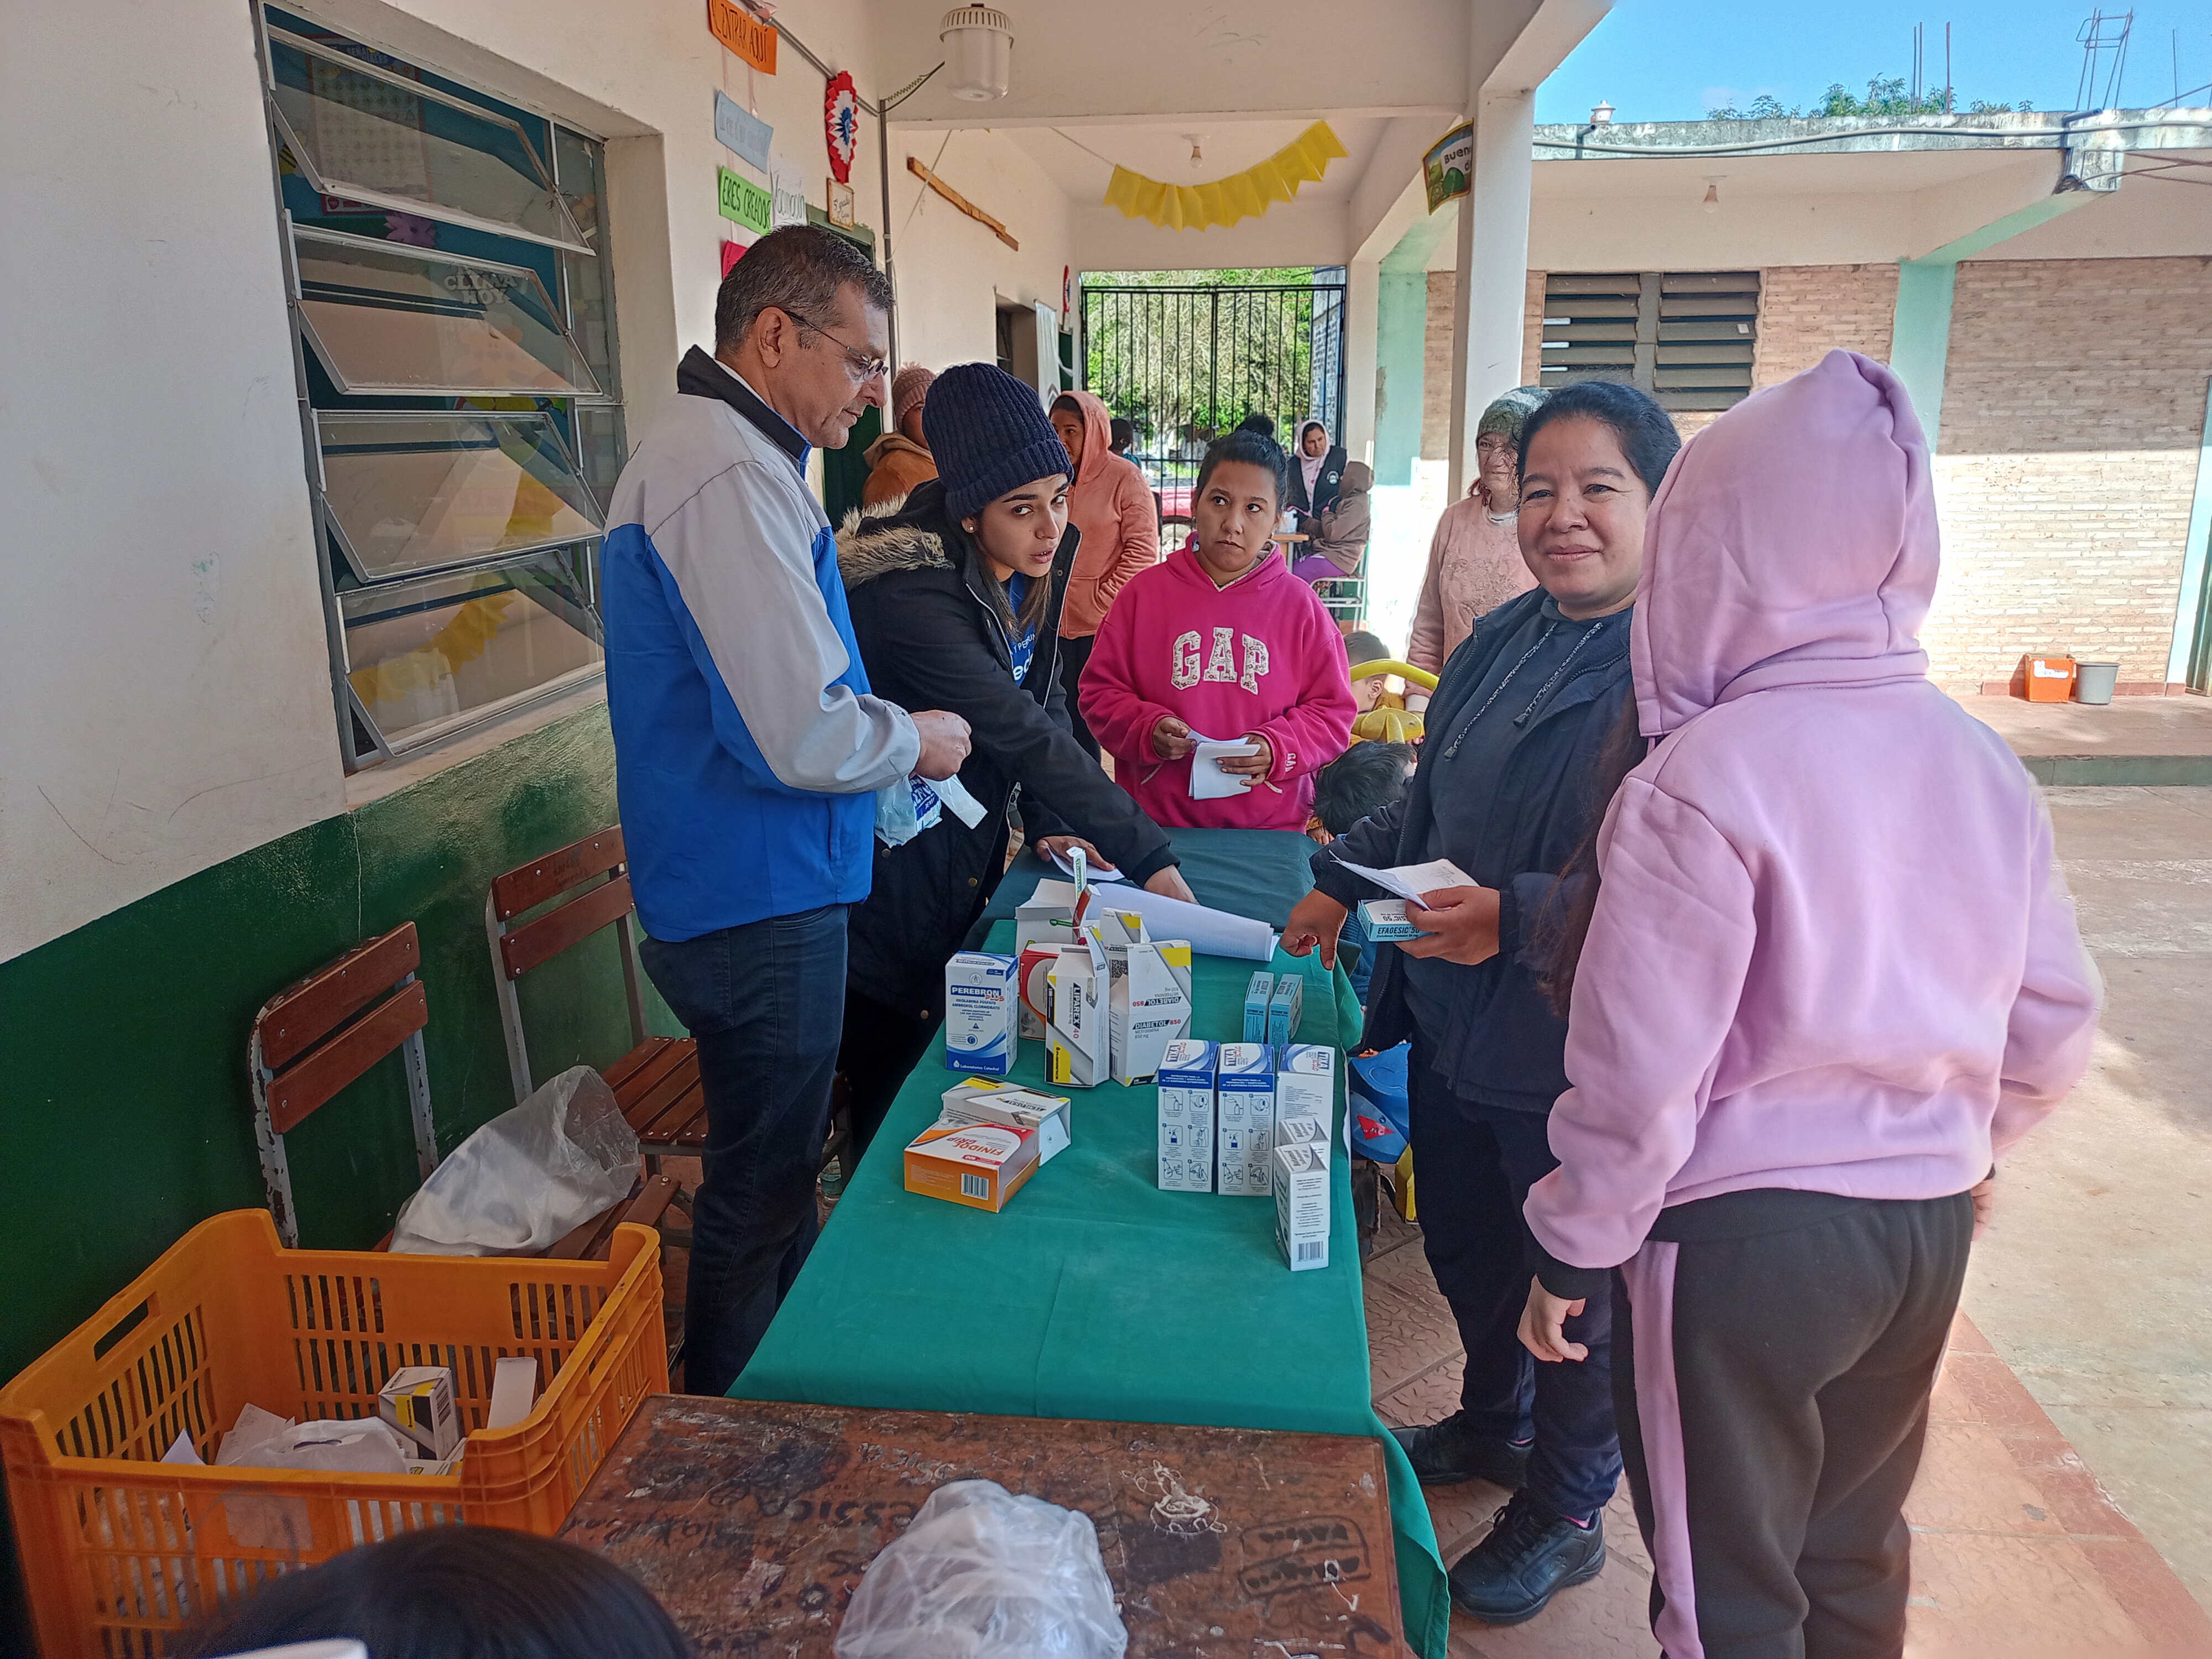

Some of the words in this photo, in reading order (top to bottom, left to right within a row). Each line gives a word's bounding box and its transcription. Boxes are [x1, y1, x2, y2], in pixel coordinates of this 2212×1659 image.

[749, 25, 768, 64] AQUÍ
[723, 175, 740, 212] ERES
[444, 274, 518, 291] CLIMA
[462, 287, 512, 305] HOY
[1171, 627, 1270, 696] GAP
[951, 987, 1000, 996] PEREBRON
[1147, 997, 1180, 1006] DIABETOL
[1135, 1020, 1168, 1029] DIABETOL
[1073, 1027, 1079, 1039] 40
[1167, 1045, 1181, 1061] TIXA
[1225, 1049, 1236, 1066] TIXA
[1318, 1053, 1329, 1068] TIXA
[946, 1136, 978, 1145] GRIP
[952, 1142, 1005, 1156] FINIDOL
